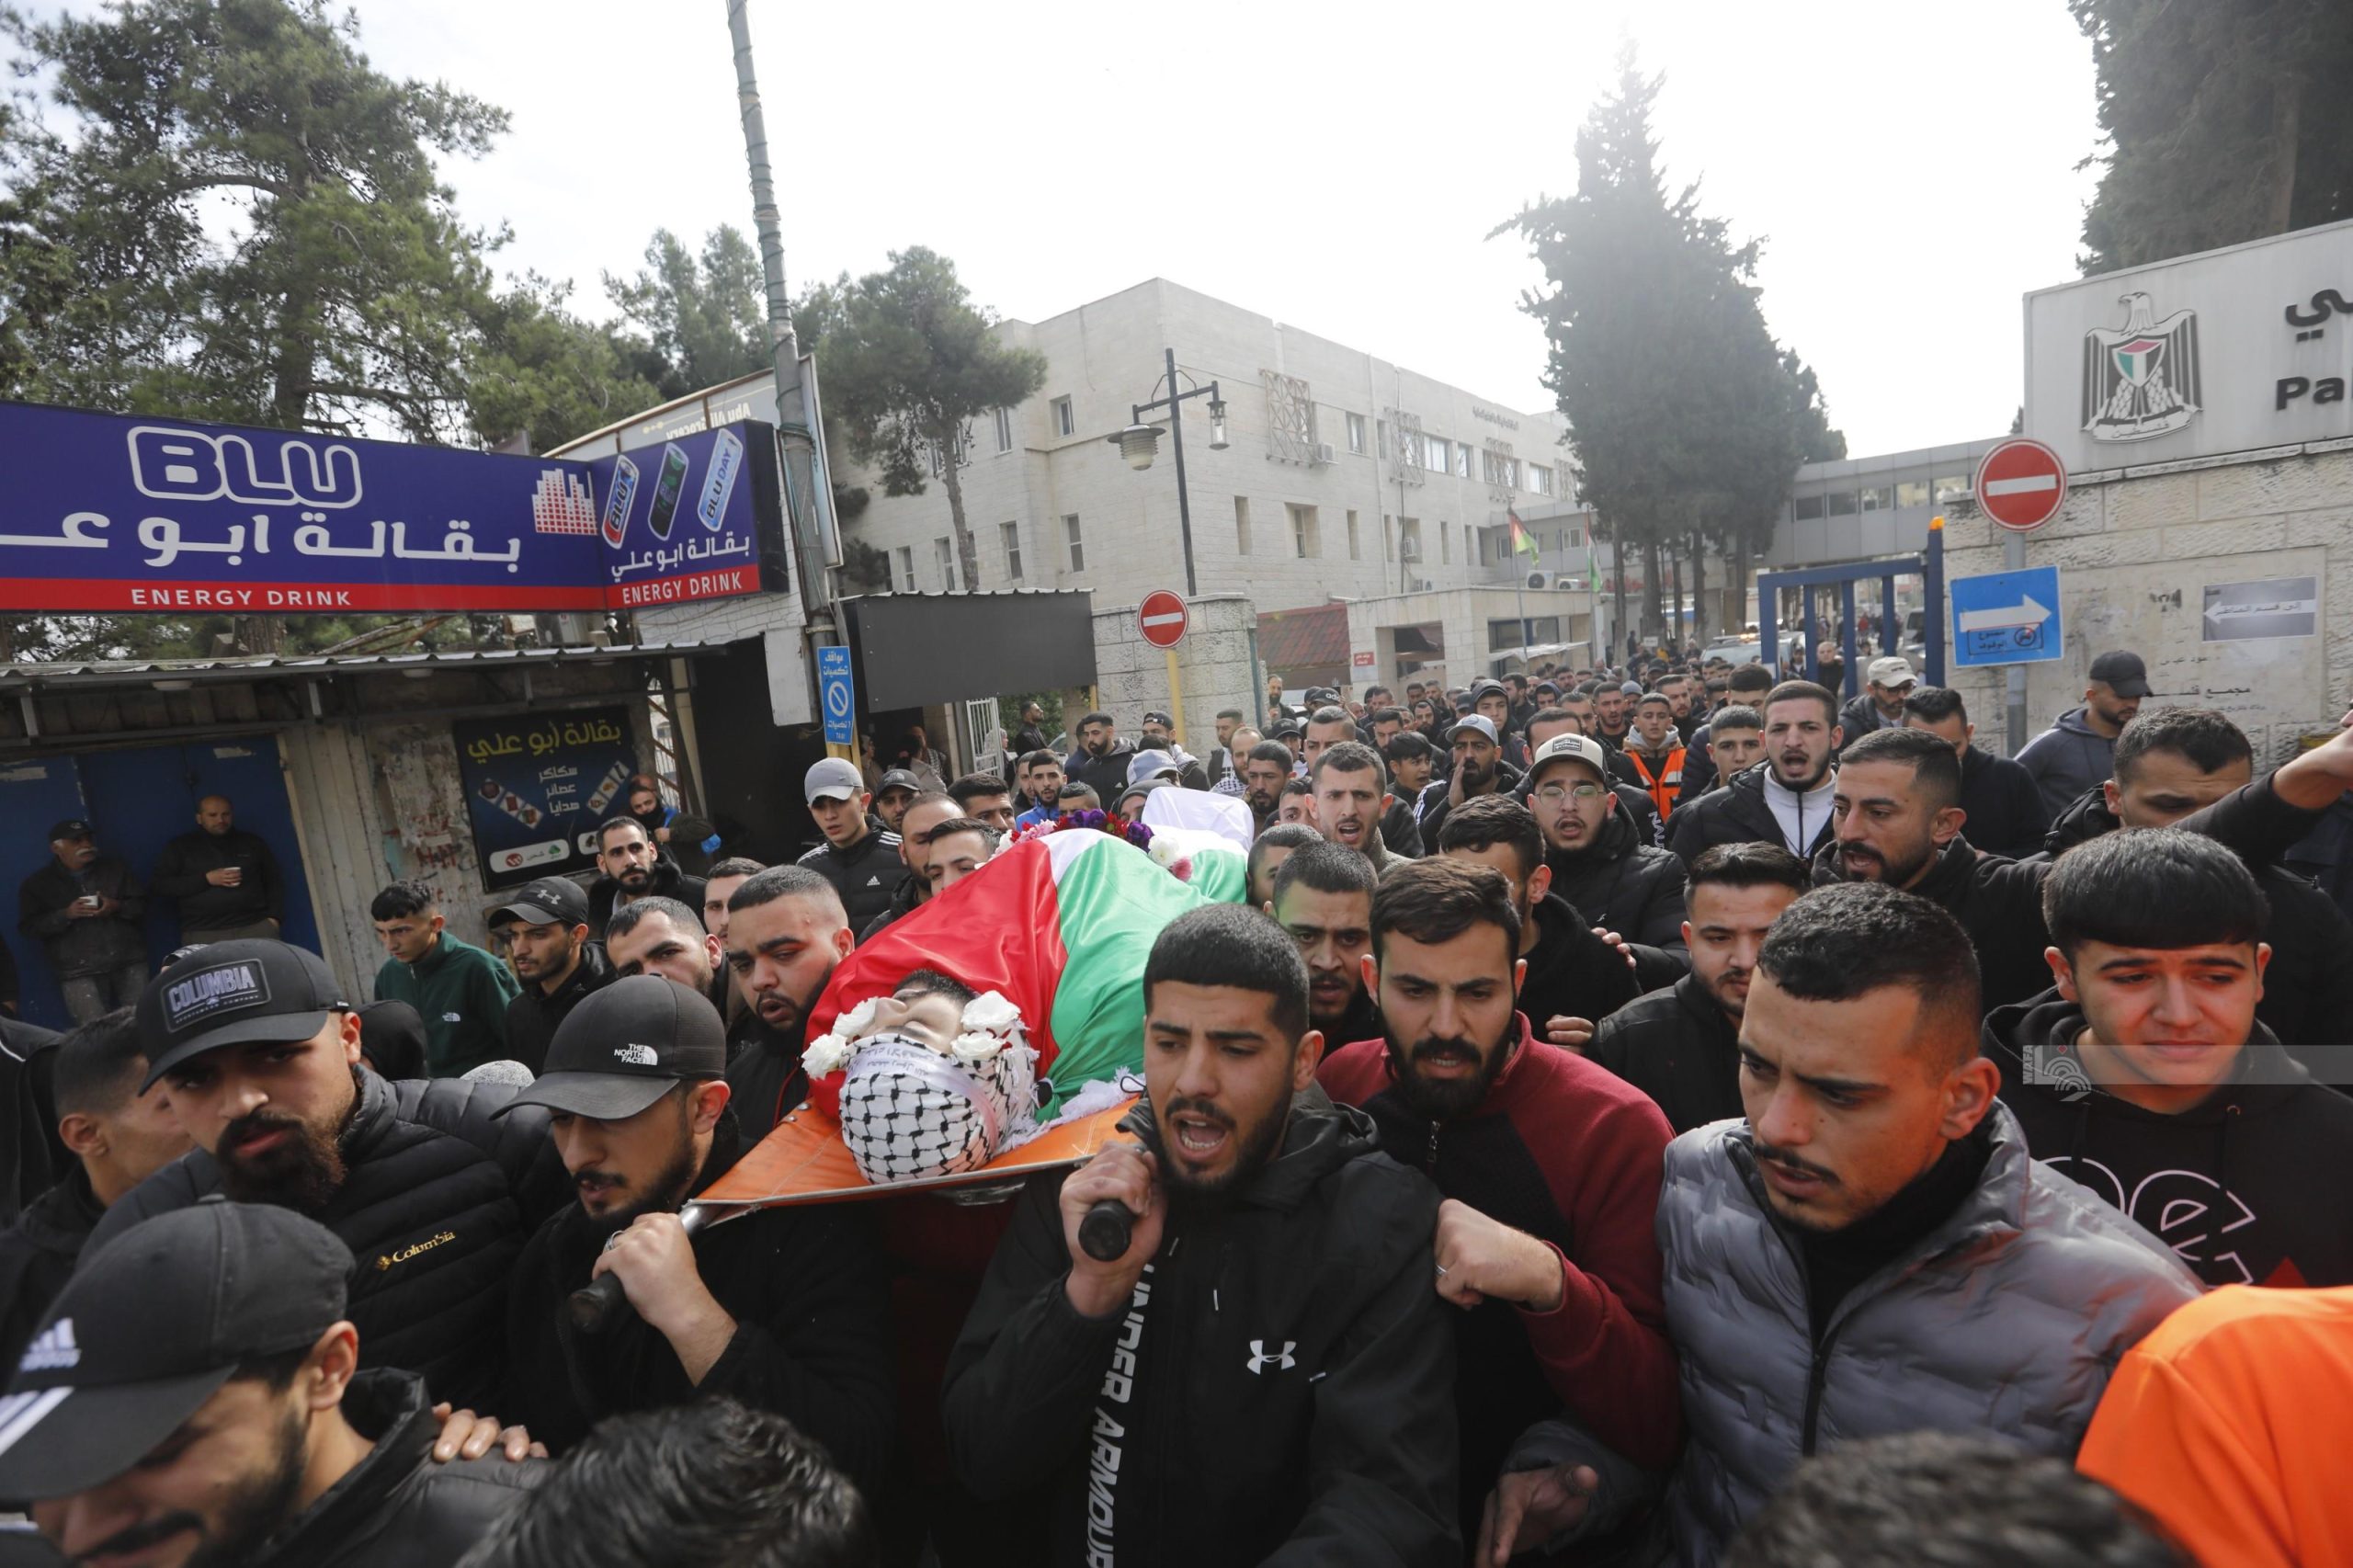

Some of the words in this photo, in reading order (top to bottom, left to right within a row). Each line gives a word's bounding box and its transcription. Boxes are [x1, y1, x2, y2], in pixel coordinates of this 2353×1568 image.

[2276, 376, 2353, 411] Pa
[127, 426, 363, 509] BLU
[706, 482, 724, 520] BLU
[717, 448, 734, 482] DAY
[609, 475, 630, 531] BLU
[137, 513, 271, 568] ابو
[292, 511, 521, 574] بقالة
[657, 541, 684, 573] ابو
[687, 530, 751, 559] بقالة
[611, 550, 654, 584] علي
[131, 587, 253, 607] ENERGY
[267, 589, 352, 607] DRINK
[621, 580, 683, 606] ENERGY
[689, 571, 743, 597] DRINK
[467, 733, 523, 765] علي
[564, 719, 622, 746] بقالة
[168, 966, 256, 1012] COLUMBIA
[614, 1049, 643, 1058] NORTH
[628, 1042, 645, 1051] THE
[392, 1231, 456, 1263] Columbia
